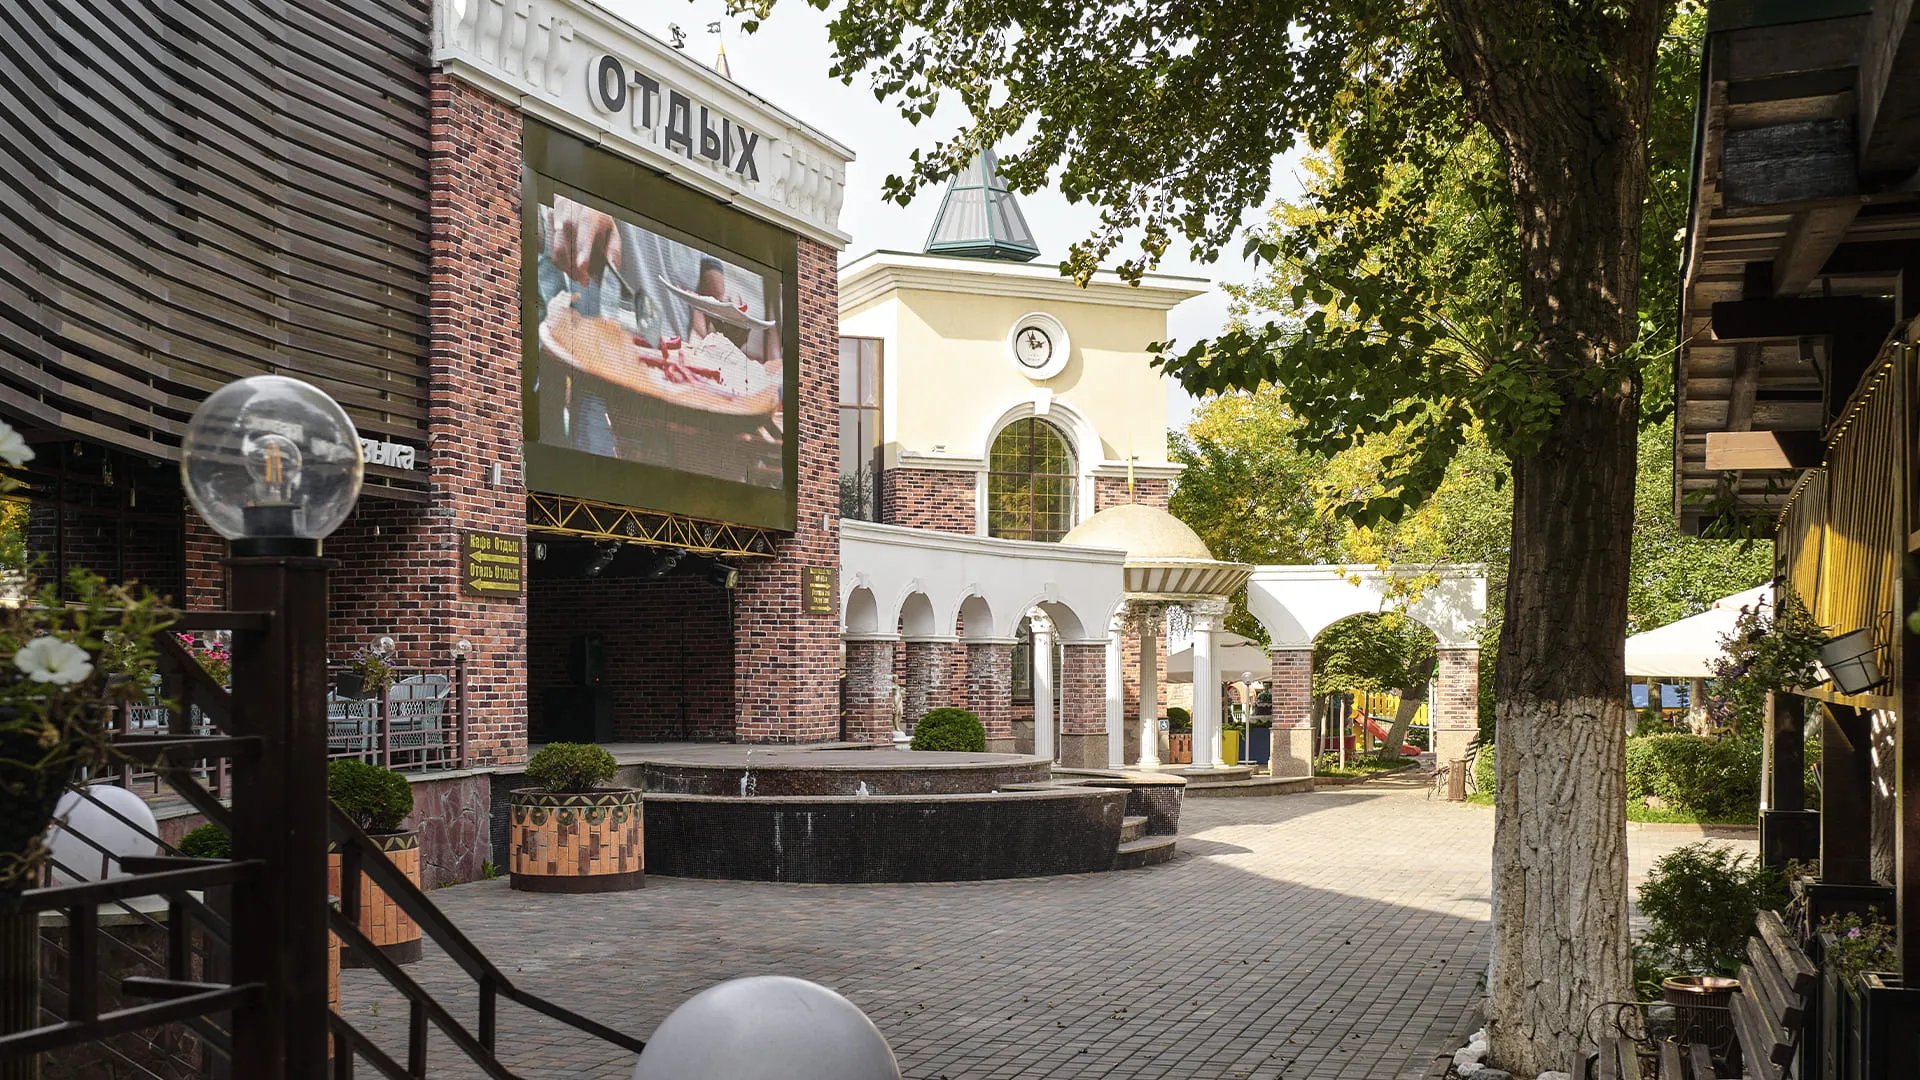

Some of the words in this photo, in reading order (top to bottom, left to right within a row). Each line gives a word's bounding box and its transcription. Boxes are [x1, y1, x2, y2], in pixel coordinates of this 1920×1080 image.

[590, 54, 760, 183] ОТДЫХ
[470, 534, 491, 550] Кафе
[495, 537, 519, 553] Отдых
[470, 563, 493, 578] Отель
[495, 566, 519, 581] Отдых
